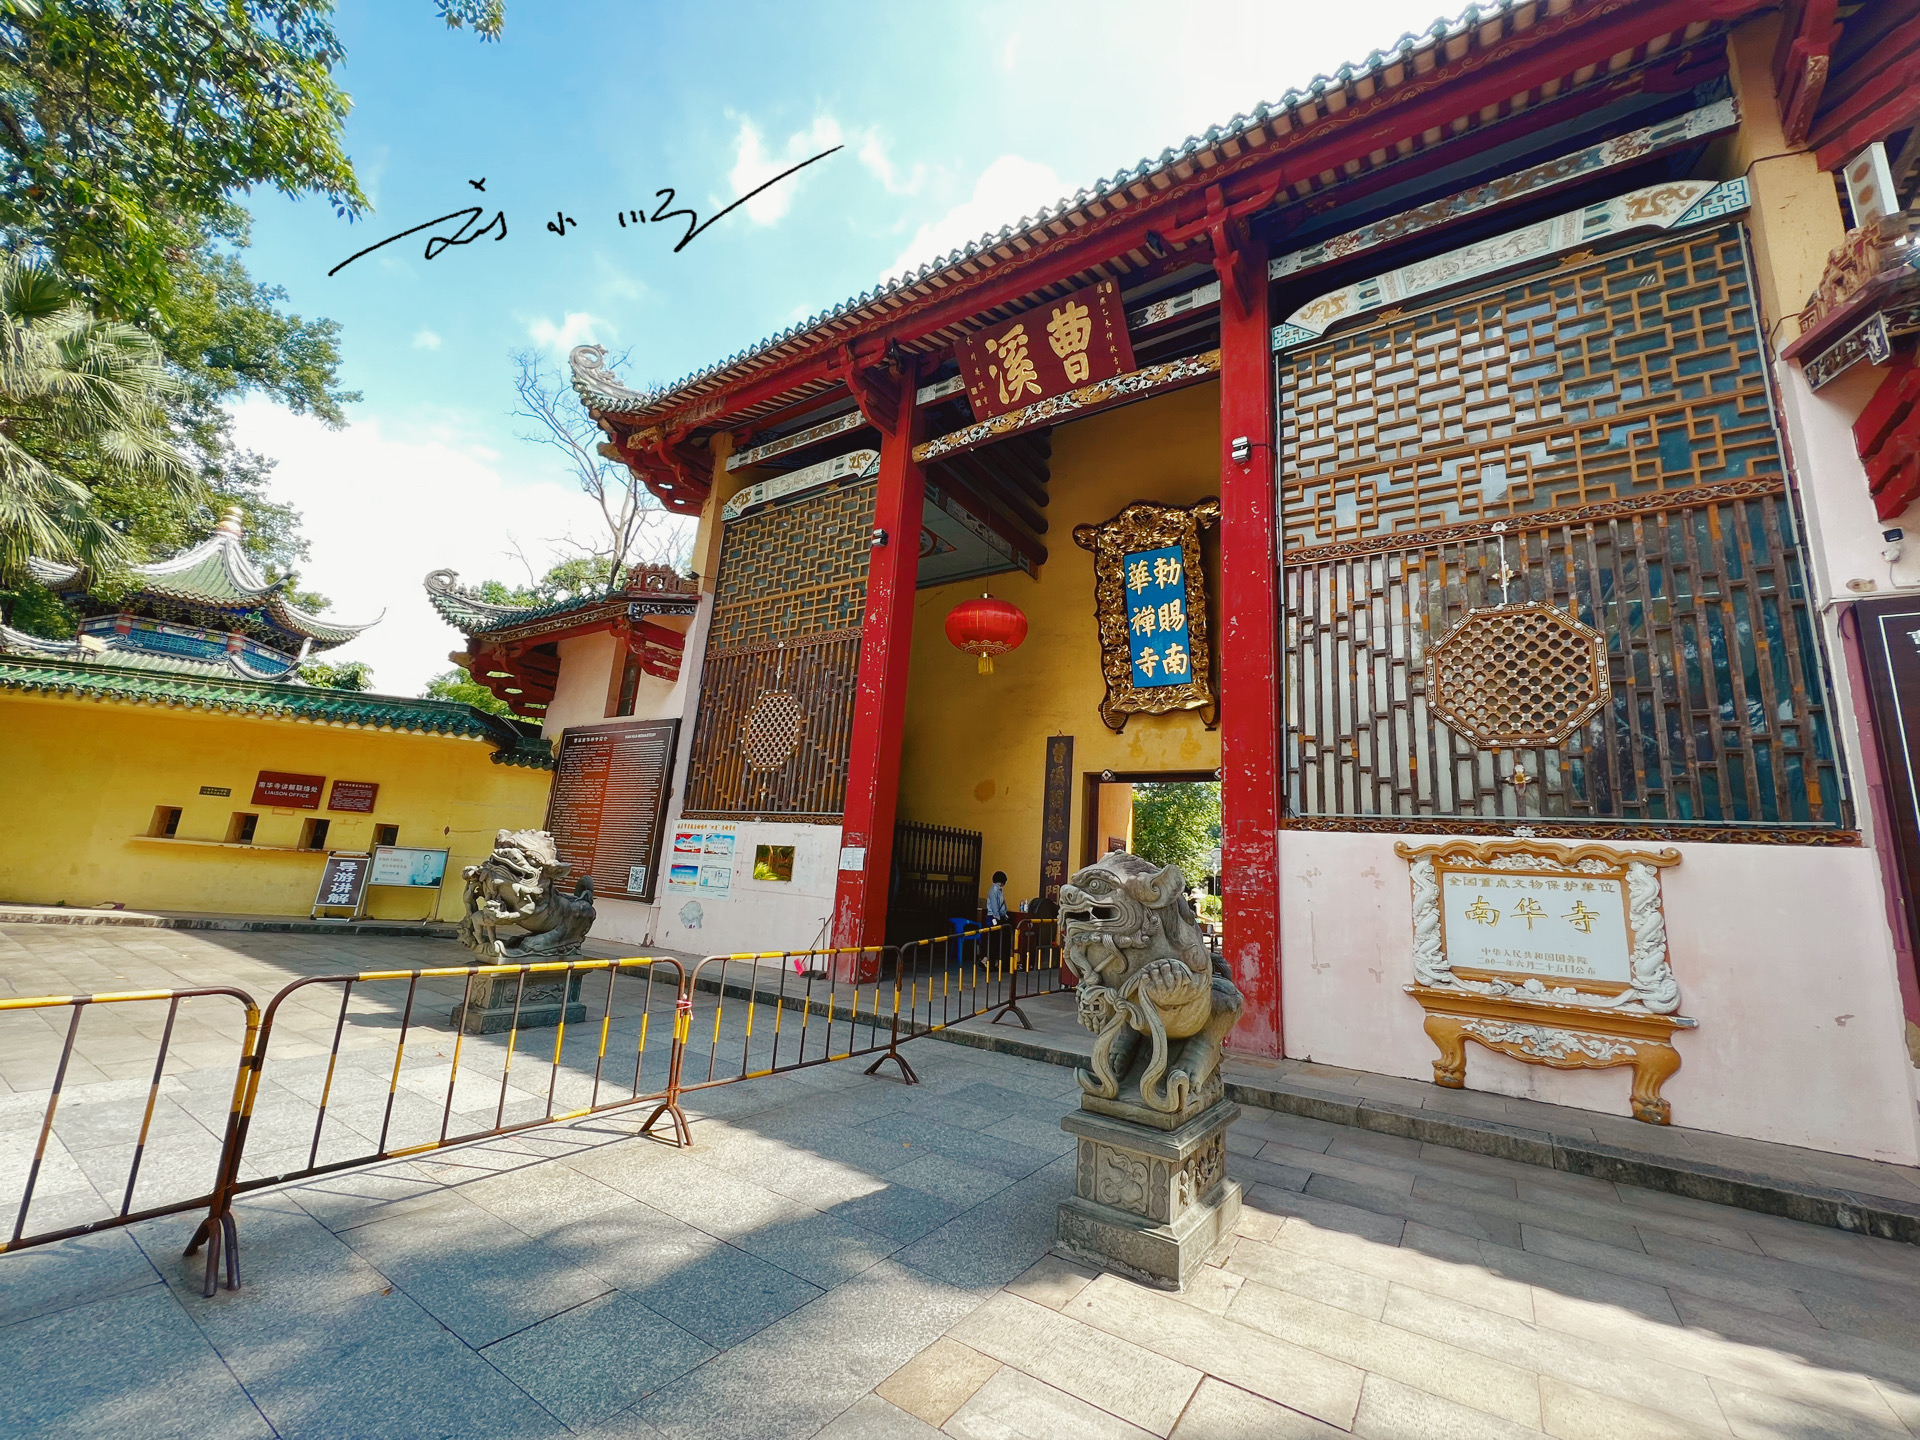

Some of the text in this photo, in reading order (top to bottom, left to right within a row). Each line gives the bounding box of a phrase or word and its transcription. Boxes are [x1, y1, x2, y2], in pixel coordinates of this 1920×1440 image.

[985, 300, 1092, 405] 曹溪
[1127, 559, 1160, 678] 華禪寺
[258, 781, 319, 793] 南华寺讲解联络处
[326, 861, 358, 904] 导游讲解
[1447, 875, 1617, 894] 全国重点文物保护单位
[1464, 895, 1601, 934] 南华寺
[1481, 947, 1588, 965] 中华人民共和国国务院
